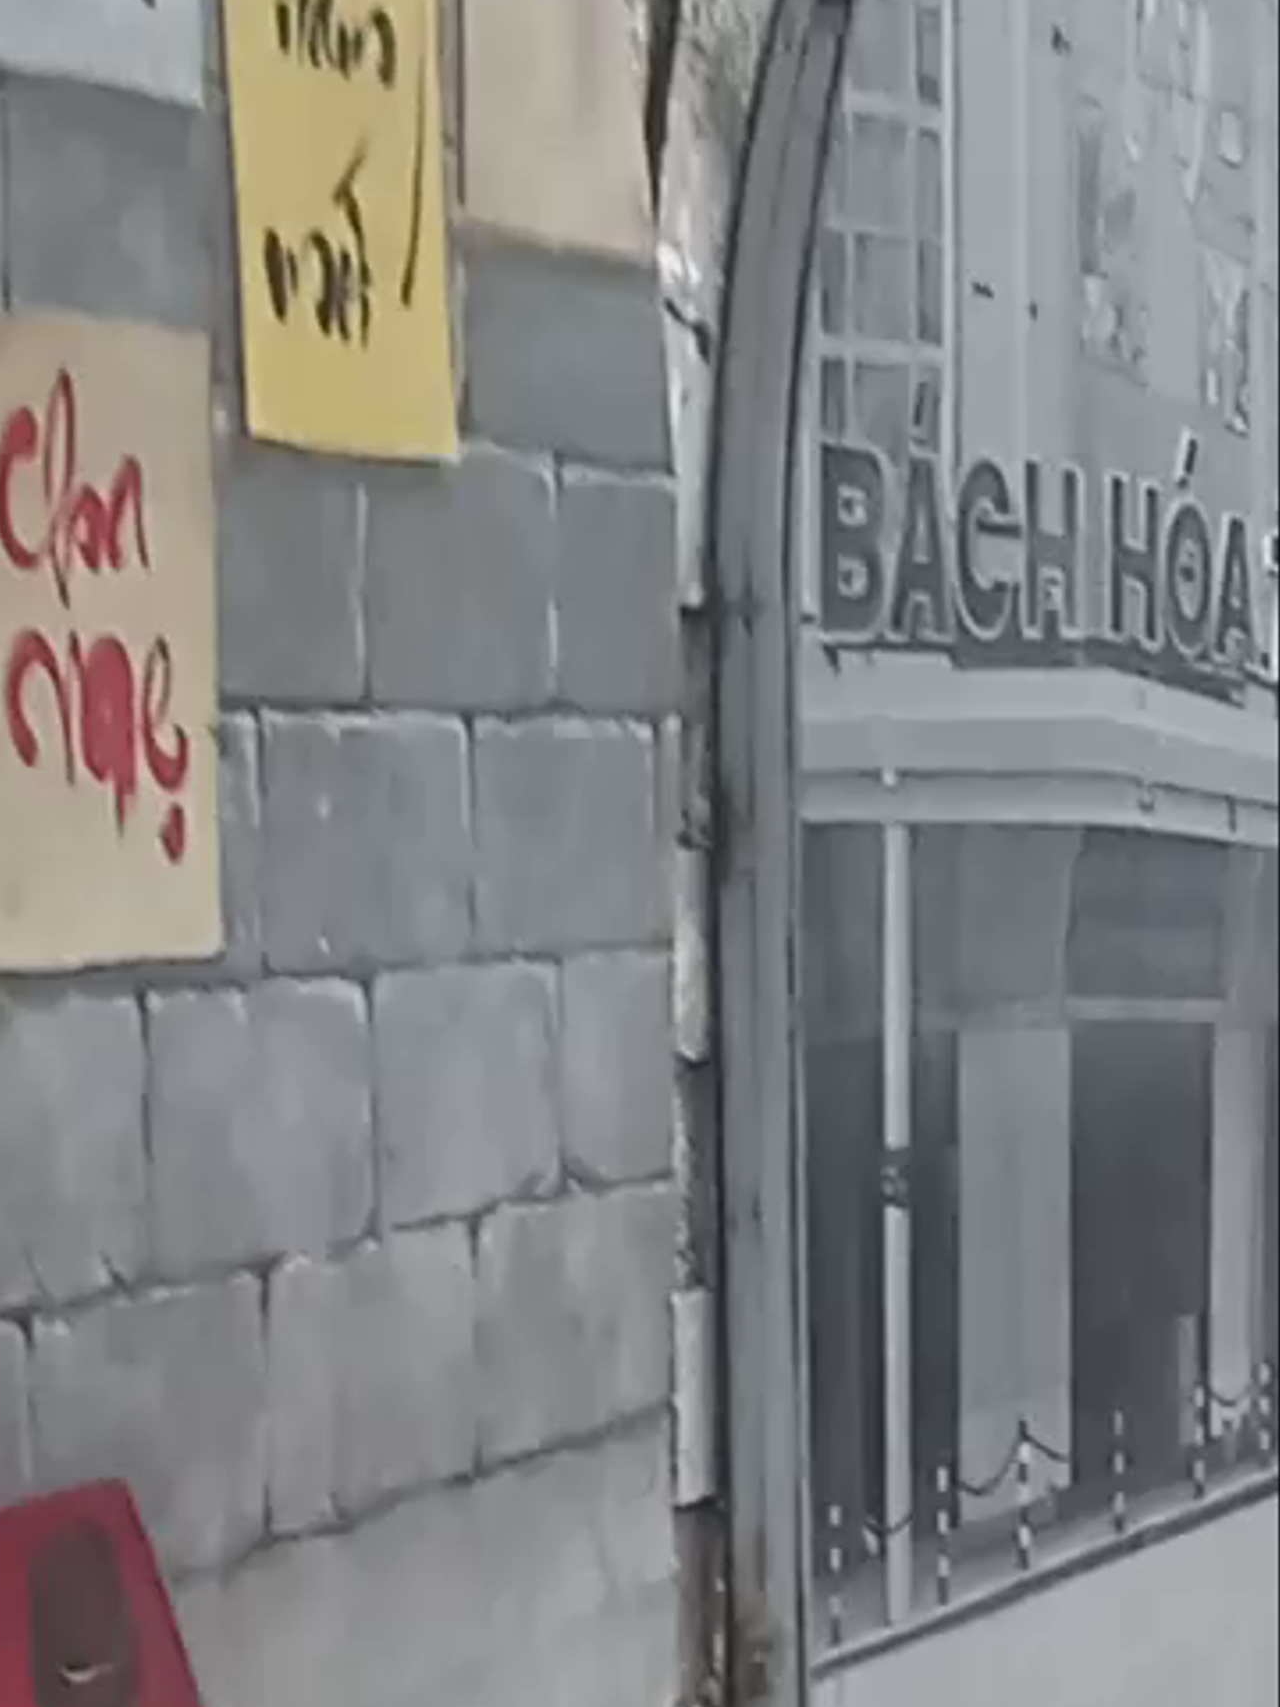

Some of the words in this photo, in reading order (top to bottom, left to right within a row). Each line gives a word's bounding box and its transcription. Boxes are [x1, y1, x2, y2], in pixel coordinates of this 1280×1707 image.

[263, 135, 371, 349] mới
[816, 379, 1086, 643] BÁCH
[1102, 429, 1264, 669] HÓA
